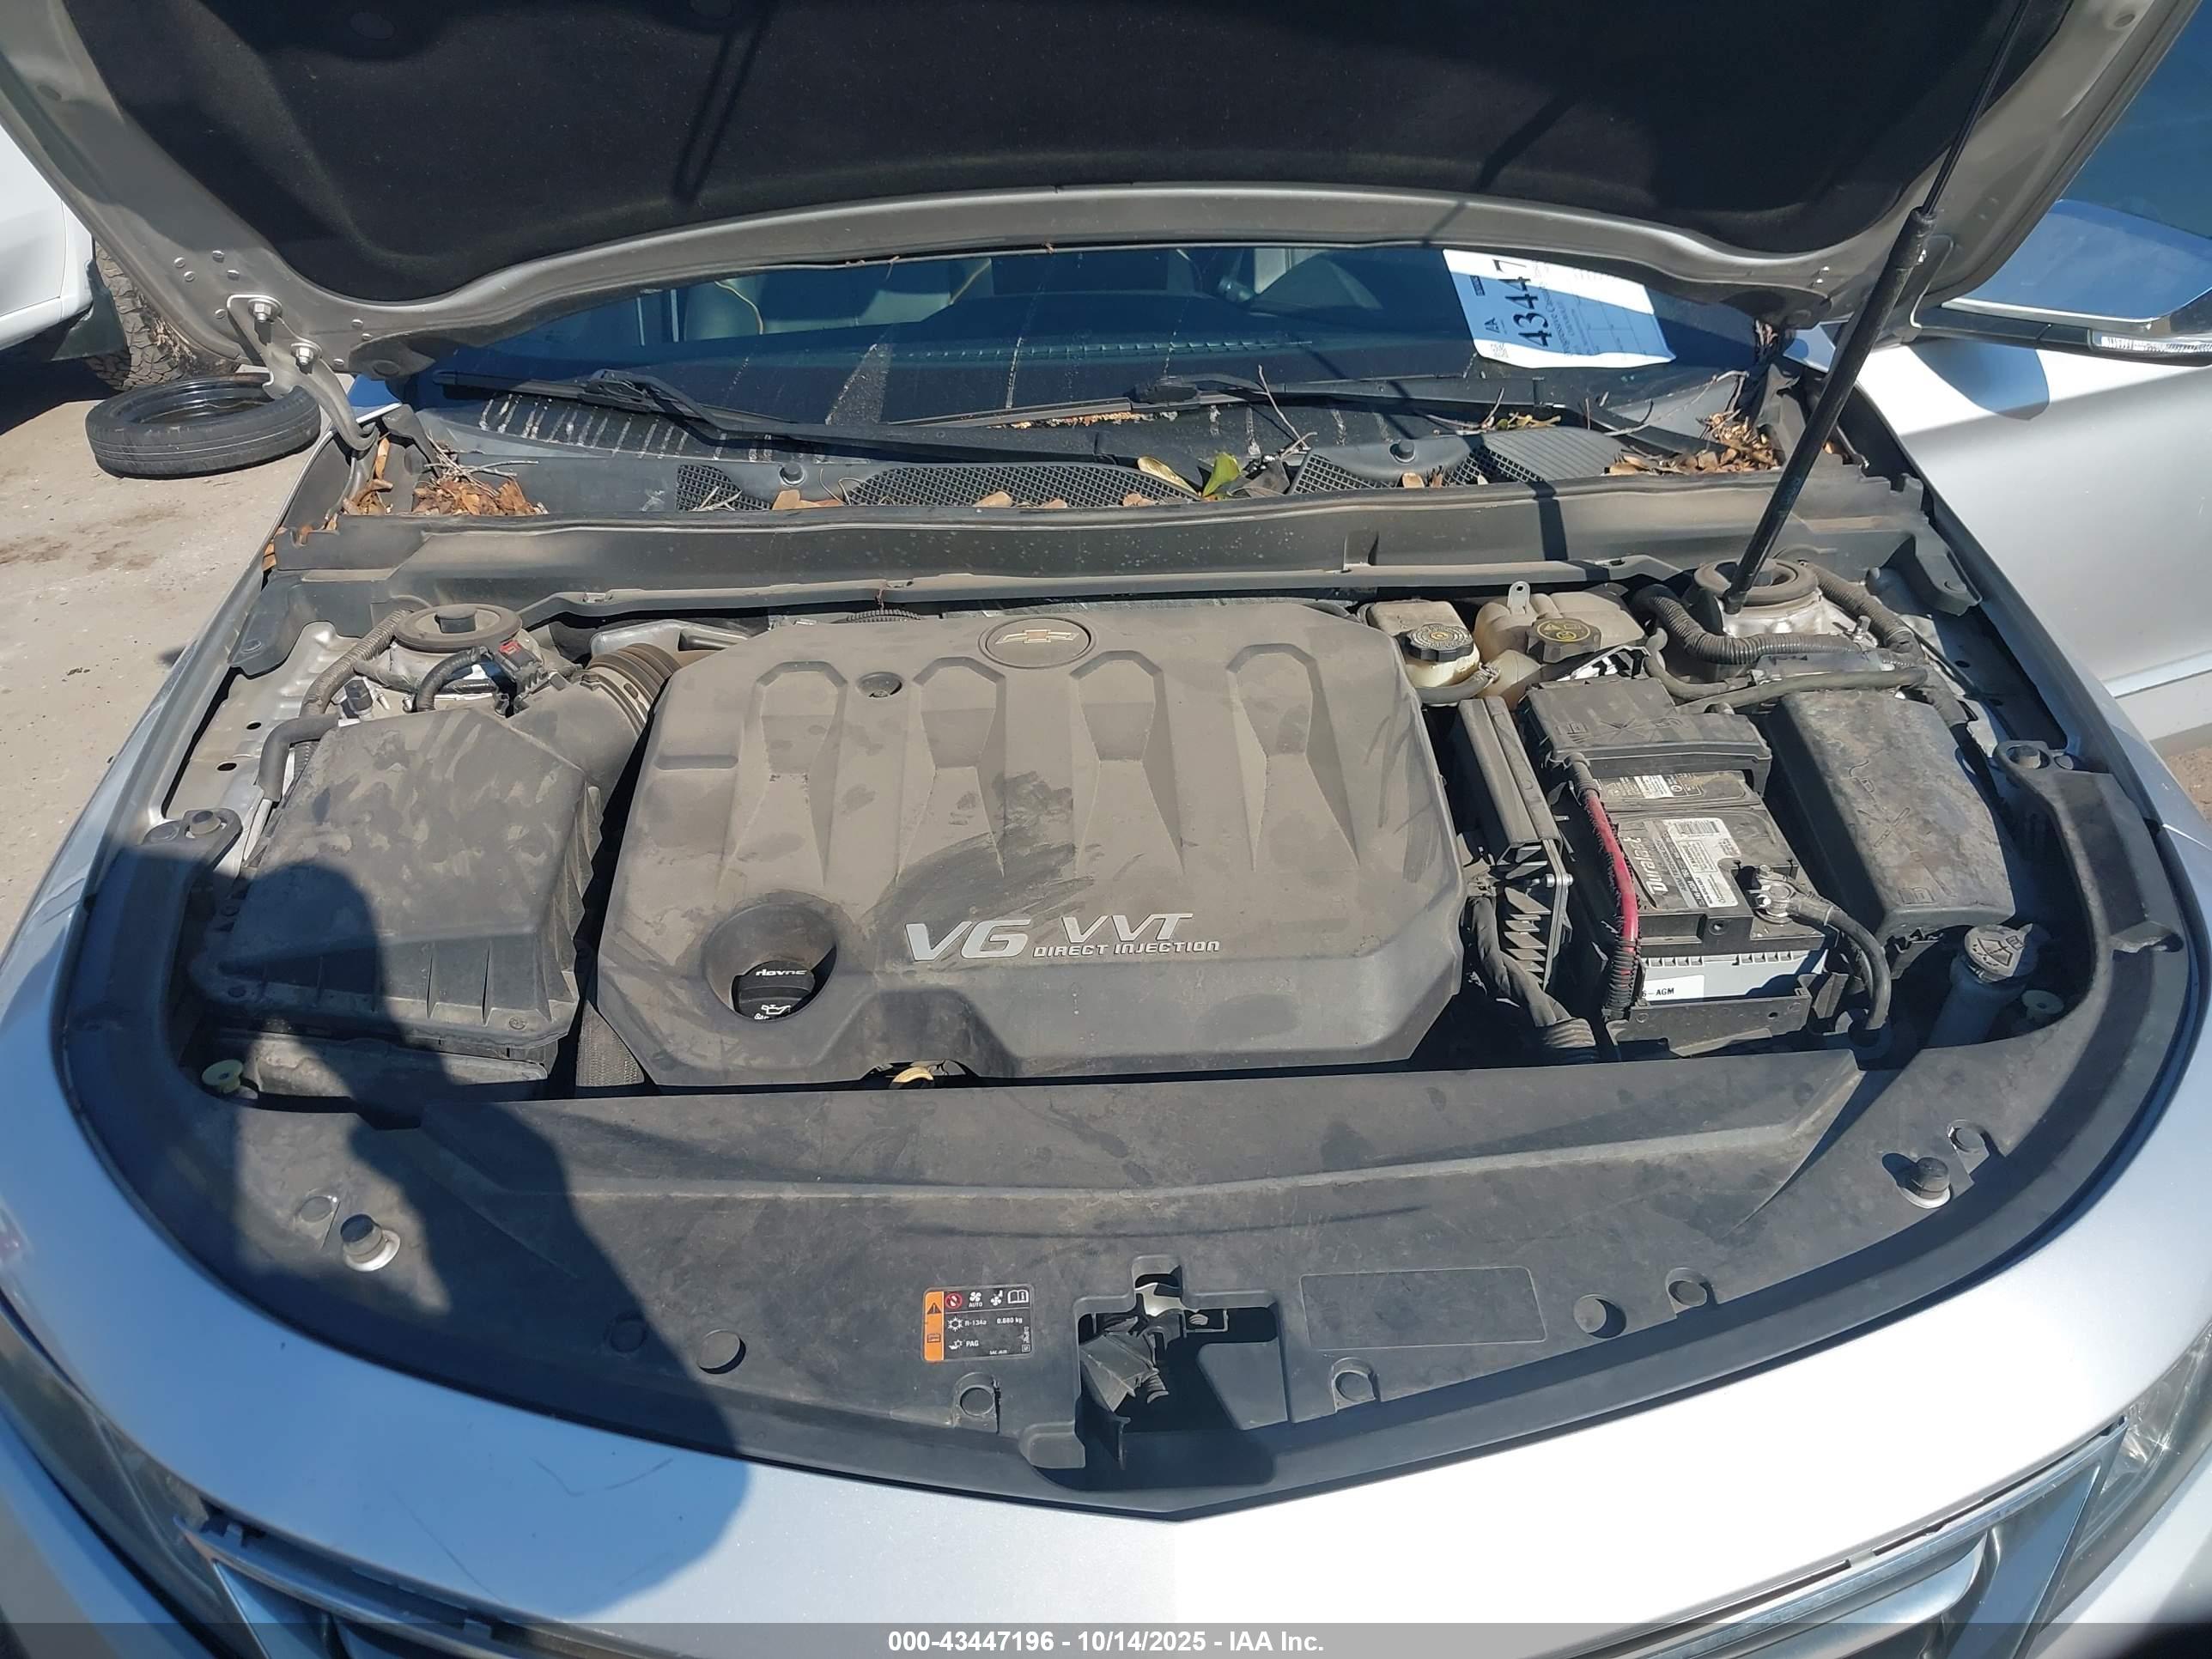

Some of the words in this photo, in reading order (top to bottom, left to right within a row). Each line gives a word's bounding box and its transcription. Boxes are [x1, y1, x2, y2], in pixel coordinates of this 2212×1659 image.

[1492, 258, 1553, 347] 43447
[904, 918, 1031, 962] V6
[1061, 912, 1194, 944] VVT
[1032, 943, 1105, 958] DIRECT
[1113, 939, 1221, 957] INJECTION
